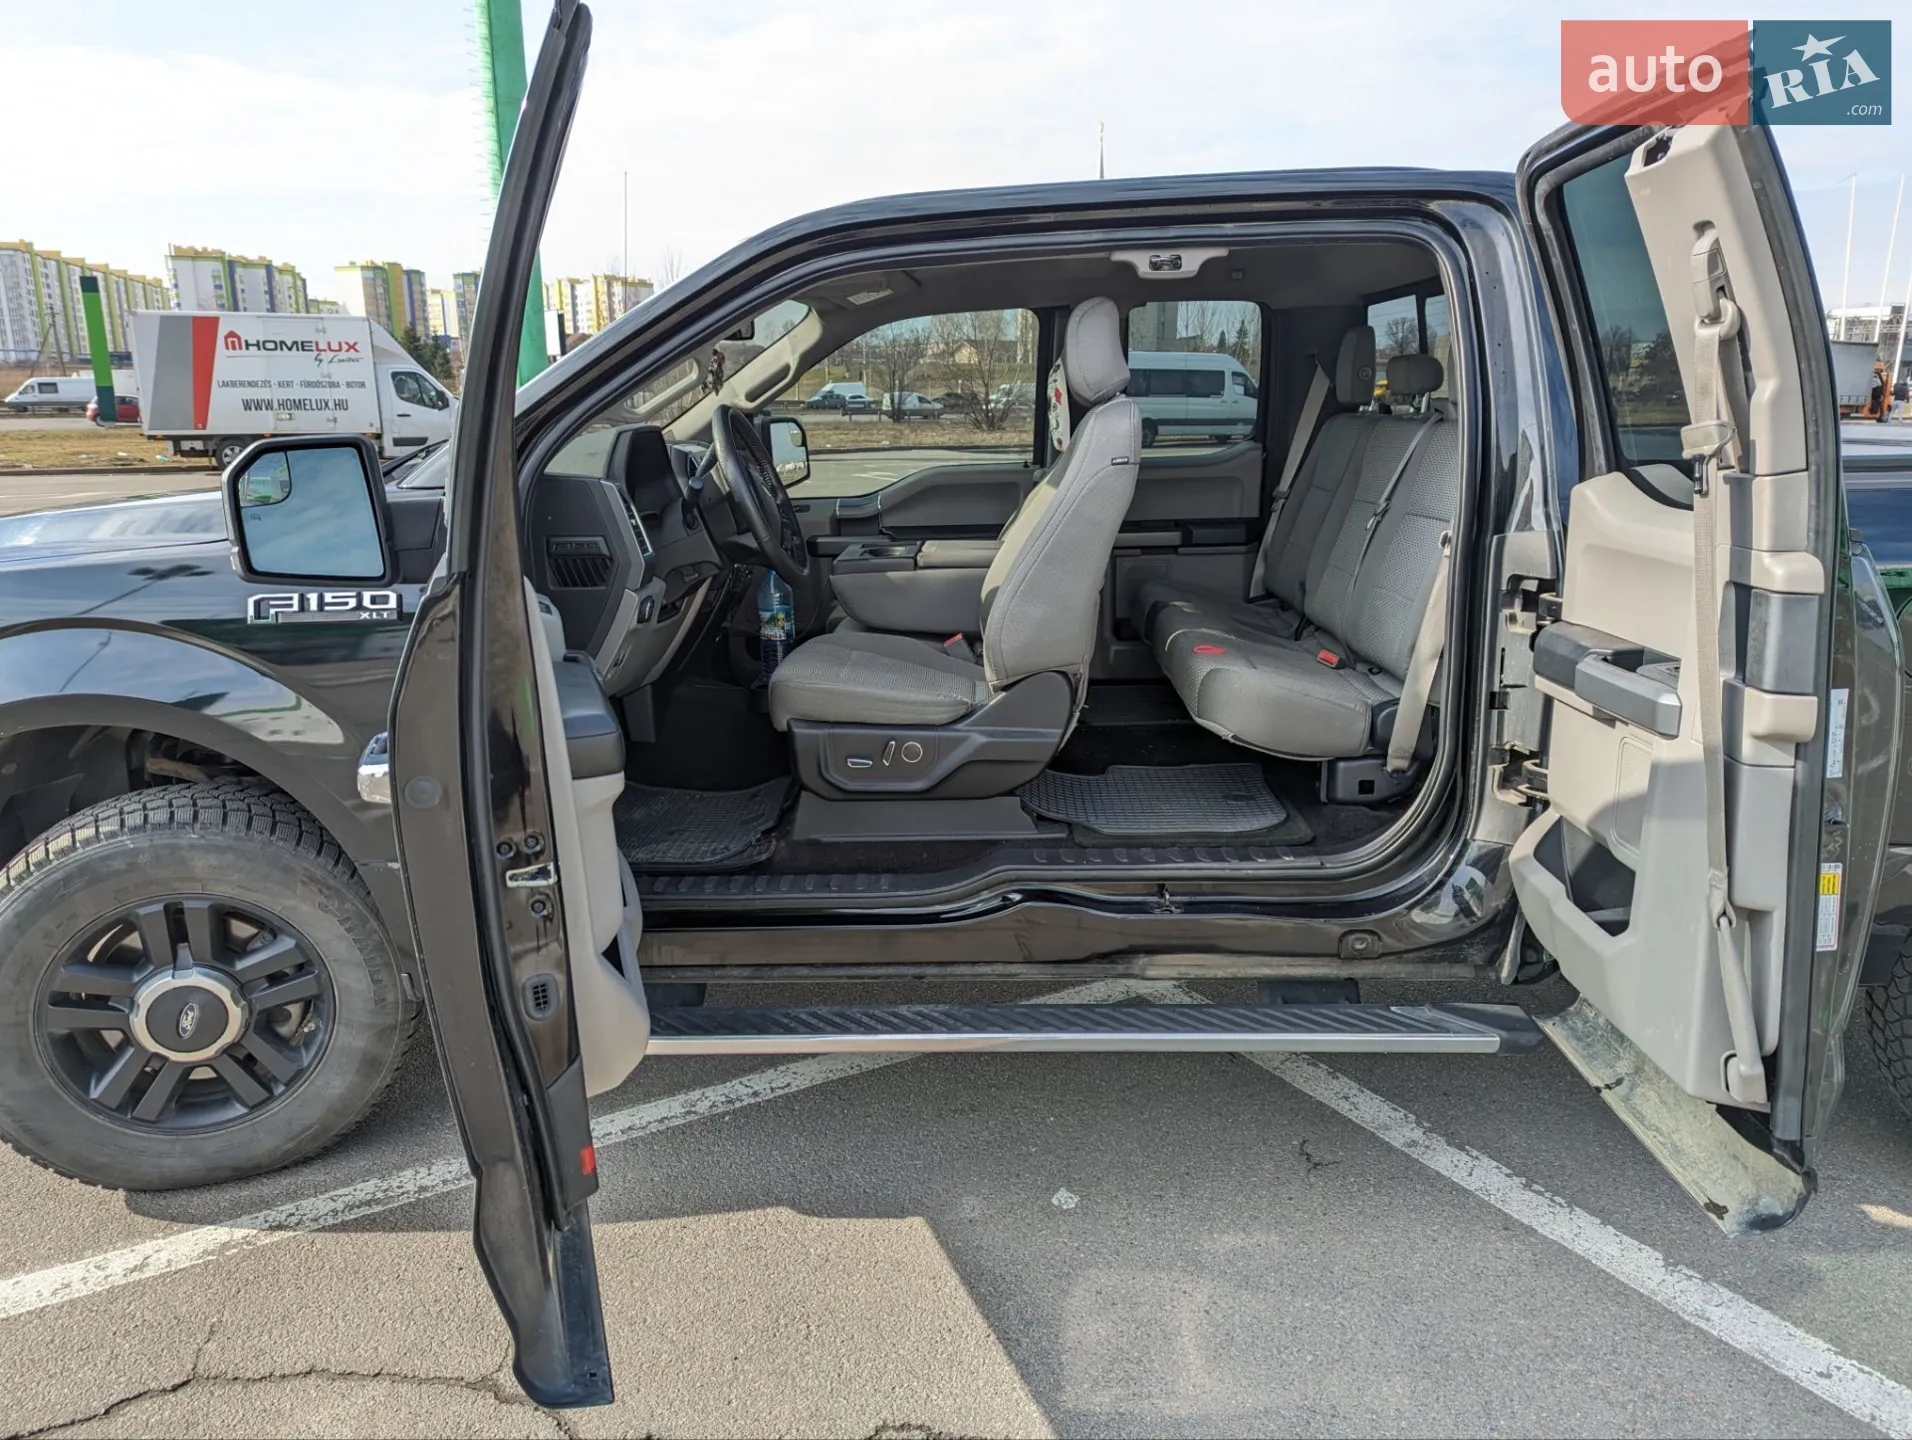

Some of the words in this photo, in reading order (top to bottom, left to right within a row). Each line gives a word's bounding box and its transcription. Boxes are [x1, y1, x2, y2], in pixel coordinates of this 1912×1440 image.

[244, 339, 361, 353] HOMELUX
[277, 380, 295, 389] KERT
[241, 398, 349, 412] WWW.HOMELUX.HU
[359, 611, 391, 620] XLT
